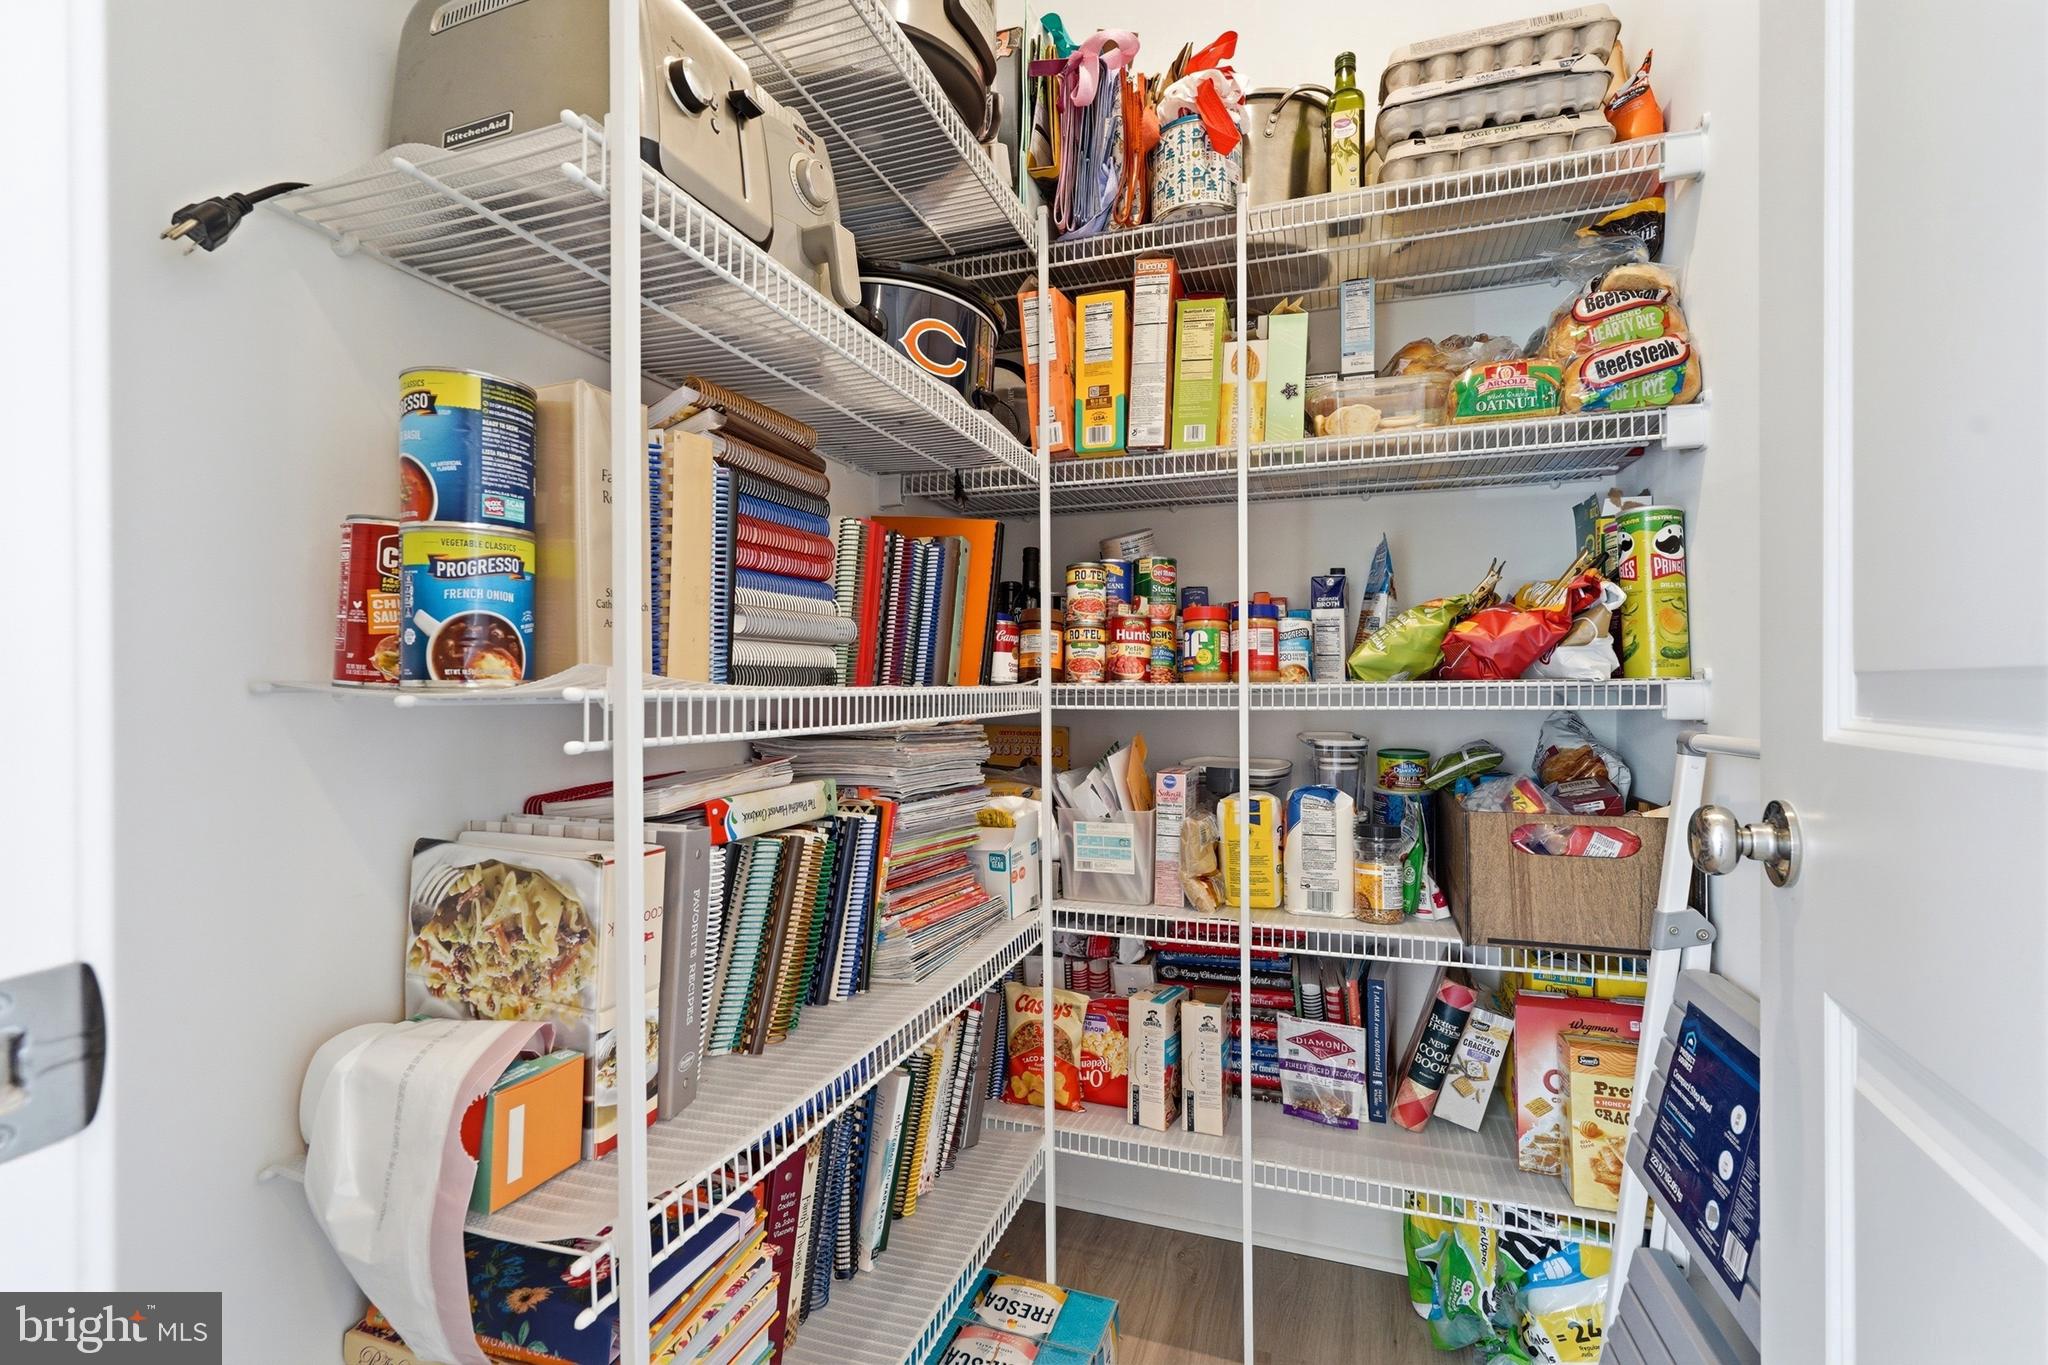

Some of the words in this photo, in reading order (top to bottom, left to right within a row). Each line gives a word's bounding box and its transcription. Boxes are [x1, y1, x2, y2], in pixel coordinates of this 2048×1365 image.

[446, 119, 507, 143] KitchenAid
[1462, 131, 1491, 140] CAGE
[1588, 322, 1636, 346] HEARTY
[1637, 312, 1658, 329] RYE
[1594, 338, 1680, 378] Beefsteak
[1487, 377, 1527, 388] ARNOLD
[1641, 376, 1666, 396] RYE
[1475, 396, 1537, 412] OATNUT
[440, 538, 483, 549] VEGETABLE
[485, 541, 517, 552] CLASSICS
[436, 556, 520, 578] PROGRESSO
[443, 588, 484, 601] FRENCH
[486, 587, 515, 603] ONION
[1184, 629, 1209, 658] if
[690, 888, 701, 959] FAVORITE
[686, 963, 697, 1026] RECIPES
[1015, 993, 1073, 1021] Casy's
[1428, 1021, 1461, 1039] Homes
[1430, 1012, 1459, 1031] Better
[1568, 1018, 1619, 1034] Wegmans
[1296, 1037, 1348, 1053] DIAMOND
[1419, 1042, 1452, 1065] COOK
[1428, 1037, 1450, 1051] NEW
[1462, 1038, 1501, 1058] CRACKERS
[1022, 1055, 1039, 1063] TACO
[1372, 1038, 1381, 1072] SCRATCH
[1414, 1052, 1448, 1075] BOOK
[1285, 1061, 1307, 1071] FINELY
[1308, 1064, 1330, 1075] DICED
[1593, 1080, 1635, 1099] Pre
[1601, 1099, 1626, 1109] HONEY
[1480, 1235, 1490, 1272] Upper
[981, 1290, 1056, 1325] FRESCA
[481, 1335, 522, 1353] WOMAN
